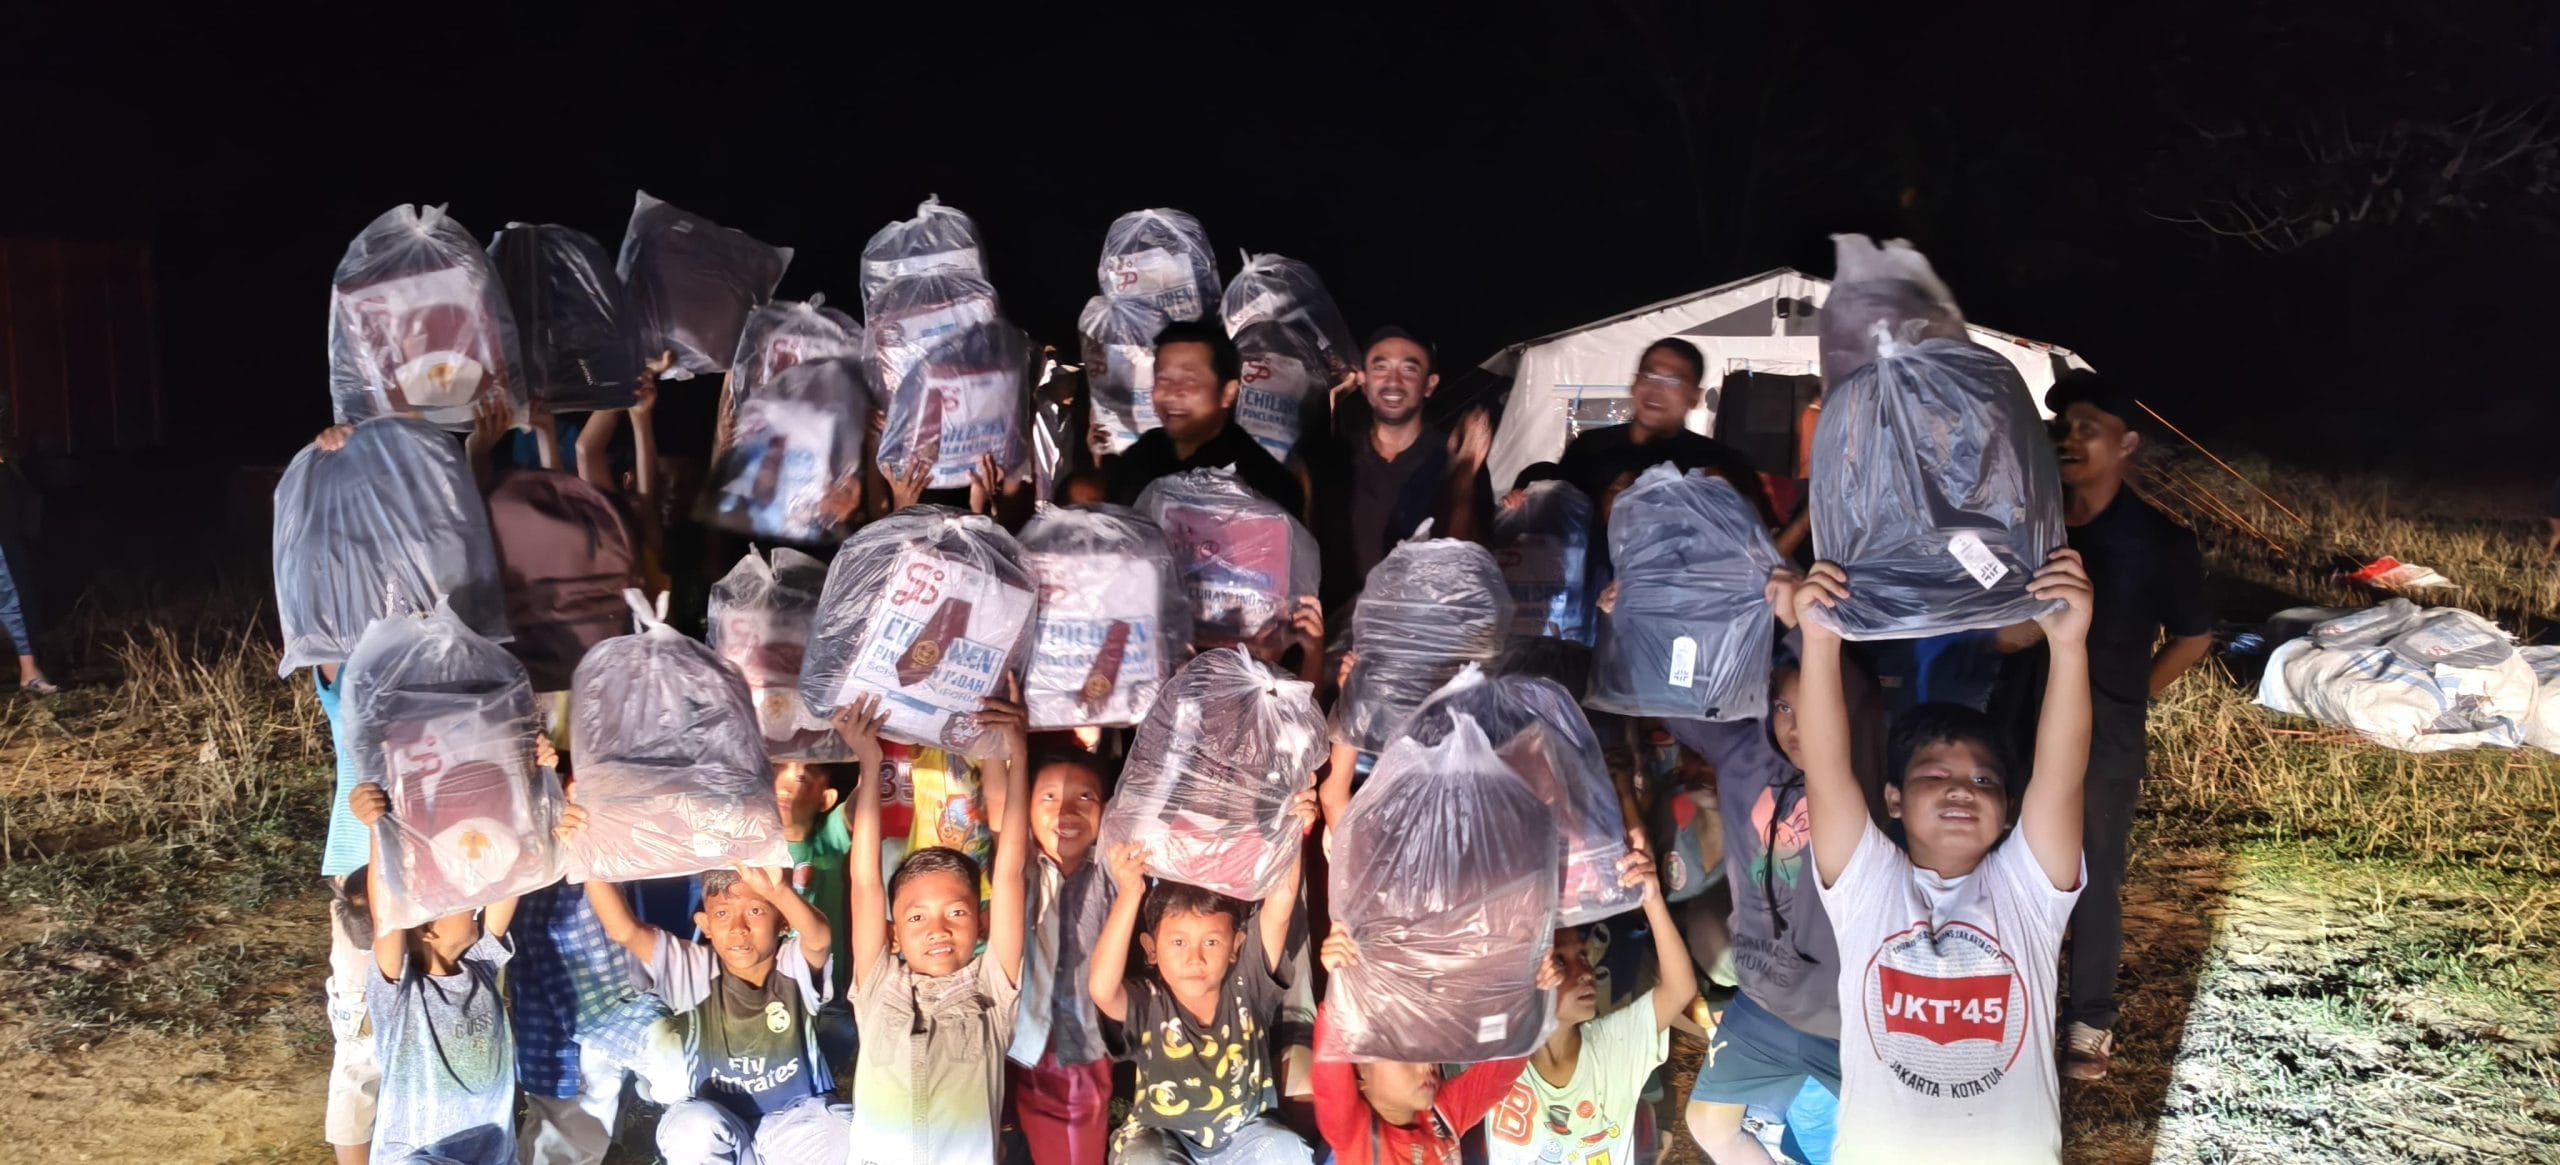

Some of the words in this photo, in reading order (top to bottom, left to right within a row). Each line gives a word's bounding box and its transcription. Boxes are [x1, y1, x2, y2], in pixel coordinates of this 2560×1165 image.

[728, 1056, 767, 1076] Fly
[1889, 1060, 1941, 1098] JAKARTA
[1950, 1081, 1985, 1099] KOTA
[1981, 1066, 2004, 1091] TUA
